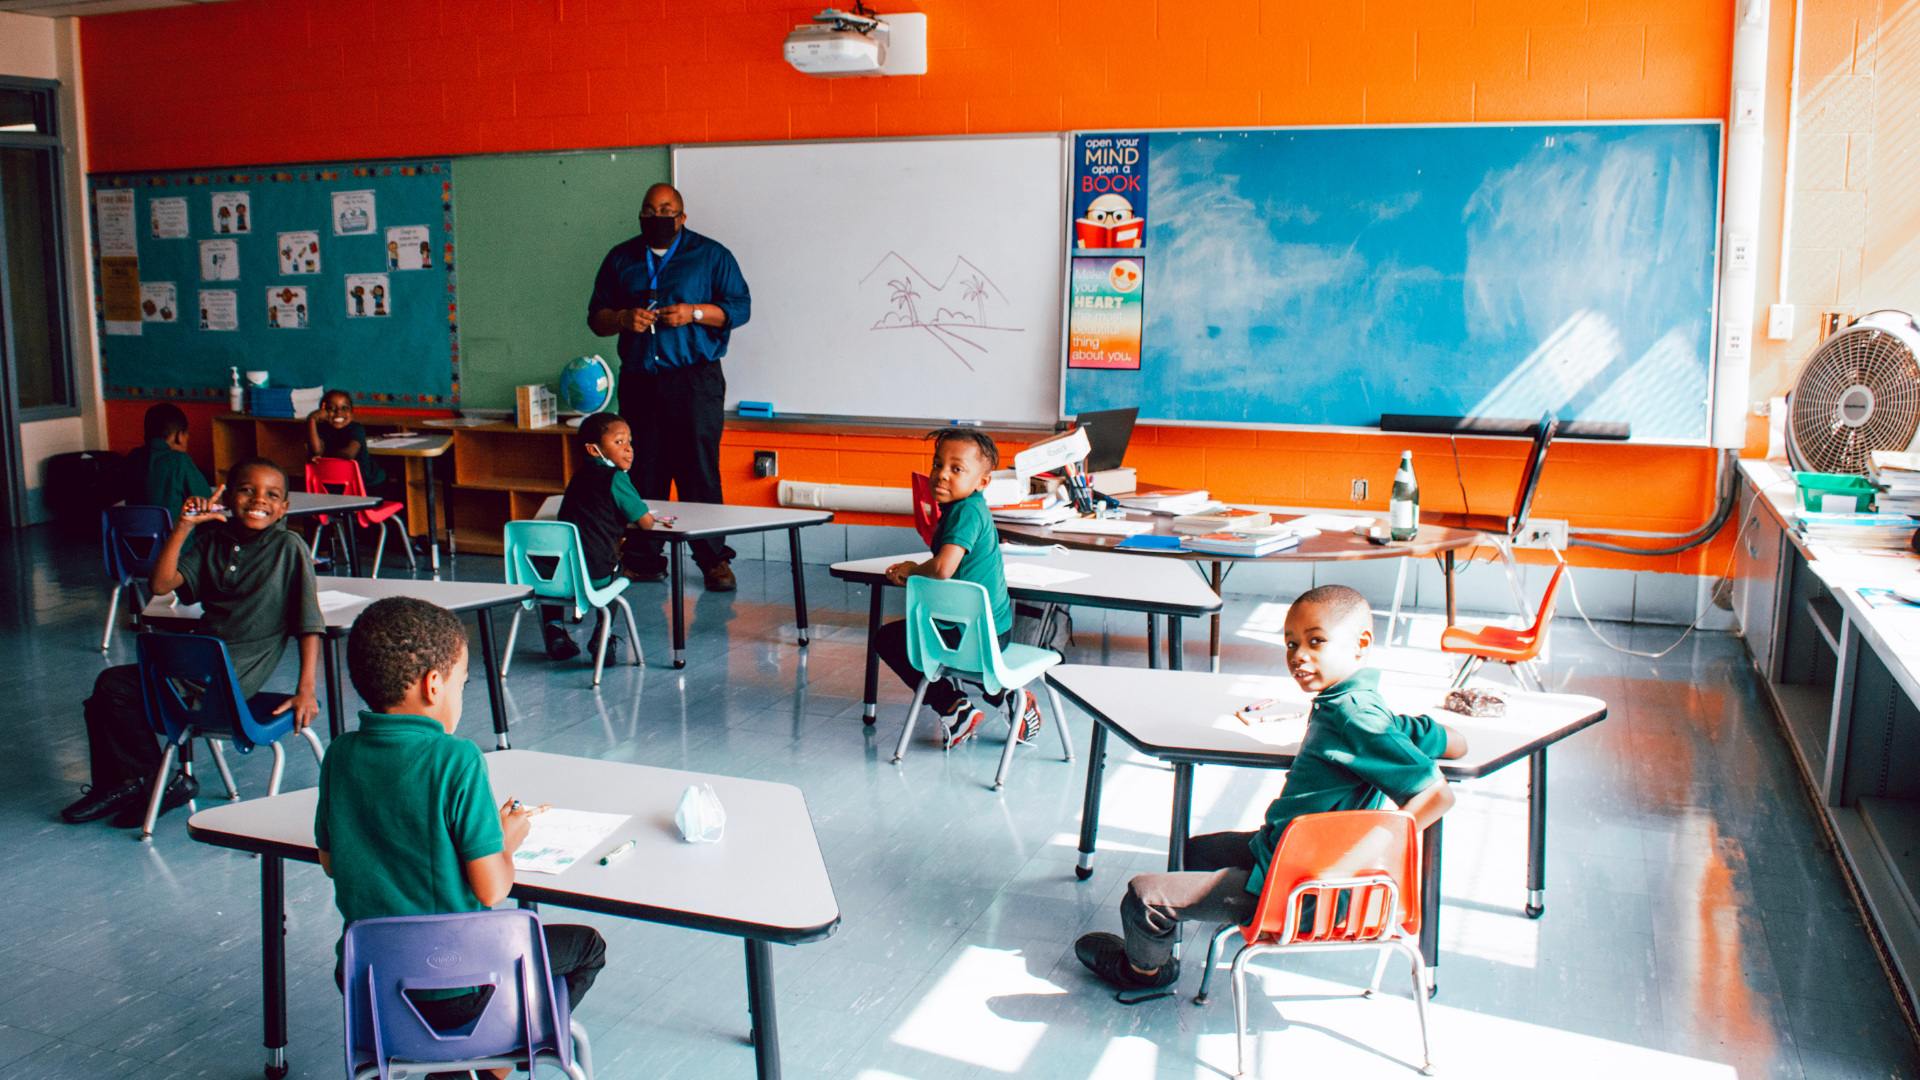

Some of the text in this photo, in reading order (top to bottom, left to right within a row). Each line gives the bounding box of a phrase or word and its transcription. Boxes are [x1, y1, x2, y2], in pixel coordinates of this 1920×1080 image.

[1085, 138, 1140, 149] open your
[1085, 147, 1140, 165] MIND
[1091, 165, 1131, 176] open a
[1082, 175, 1141, 193] BOOK
[1074, 268, 1106, 280] Make
[1074, 283, 1099, 294] your
[1074, 296, 1124, 310] HEART
[1073, 311, 1123, 322] the most
[1072, 324, 1120, 335] beautiful
[1072, 337, 1100, 350] thing
[1072, 350, 1132, 363] about you.
